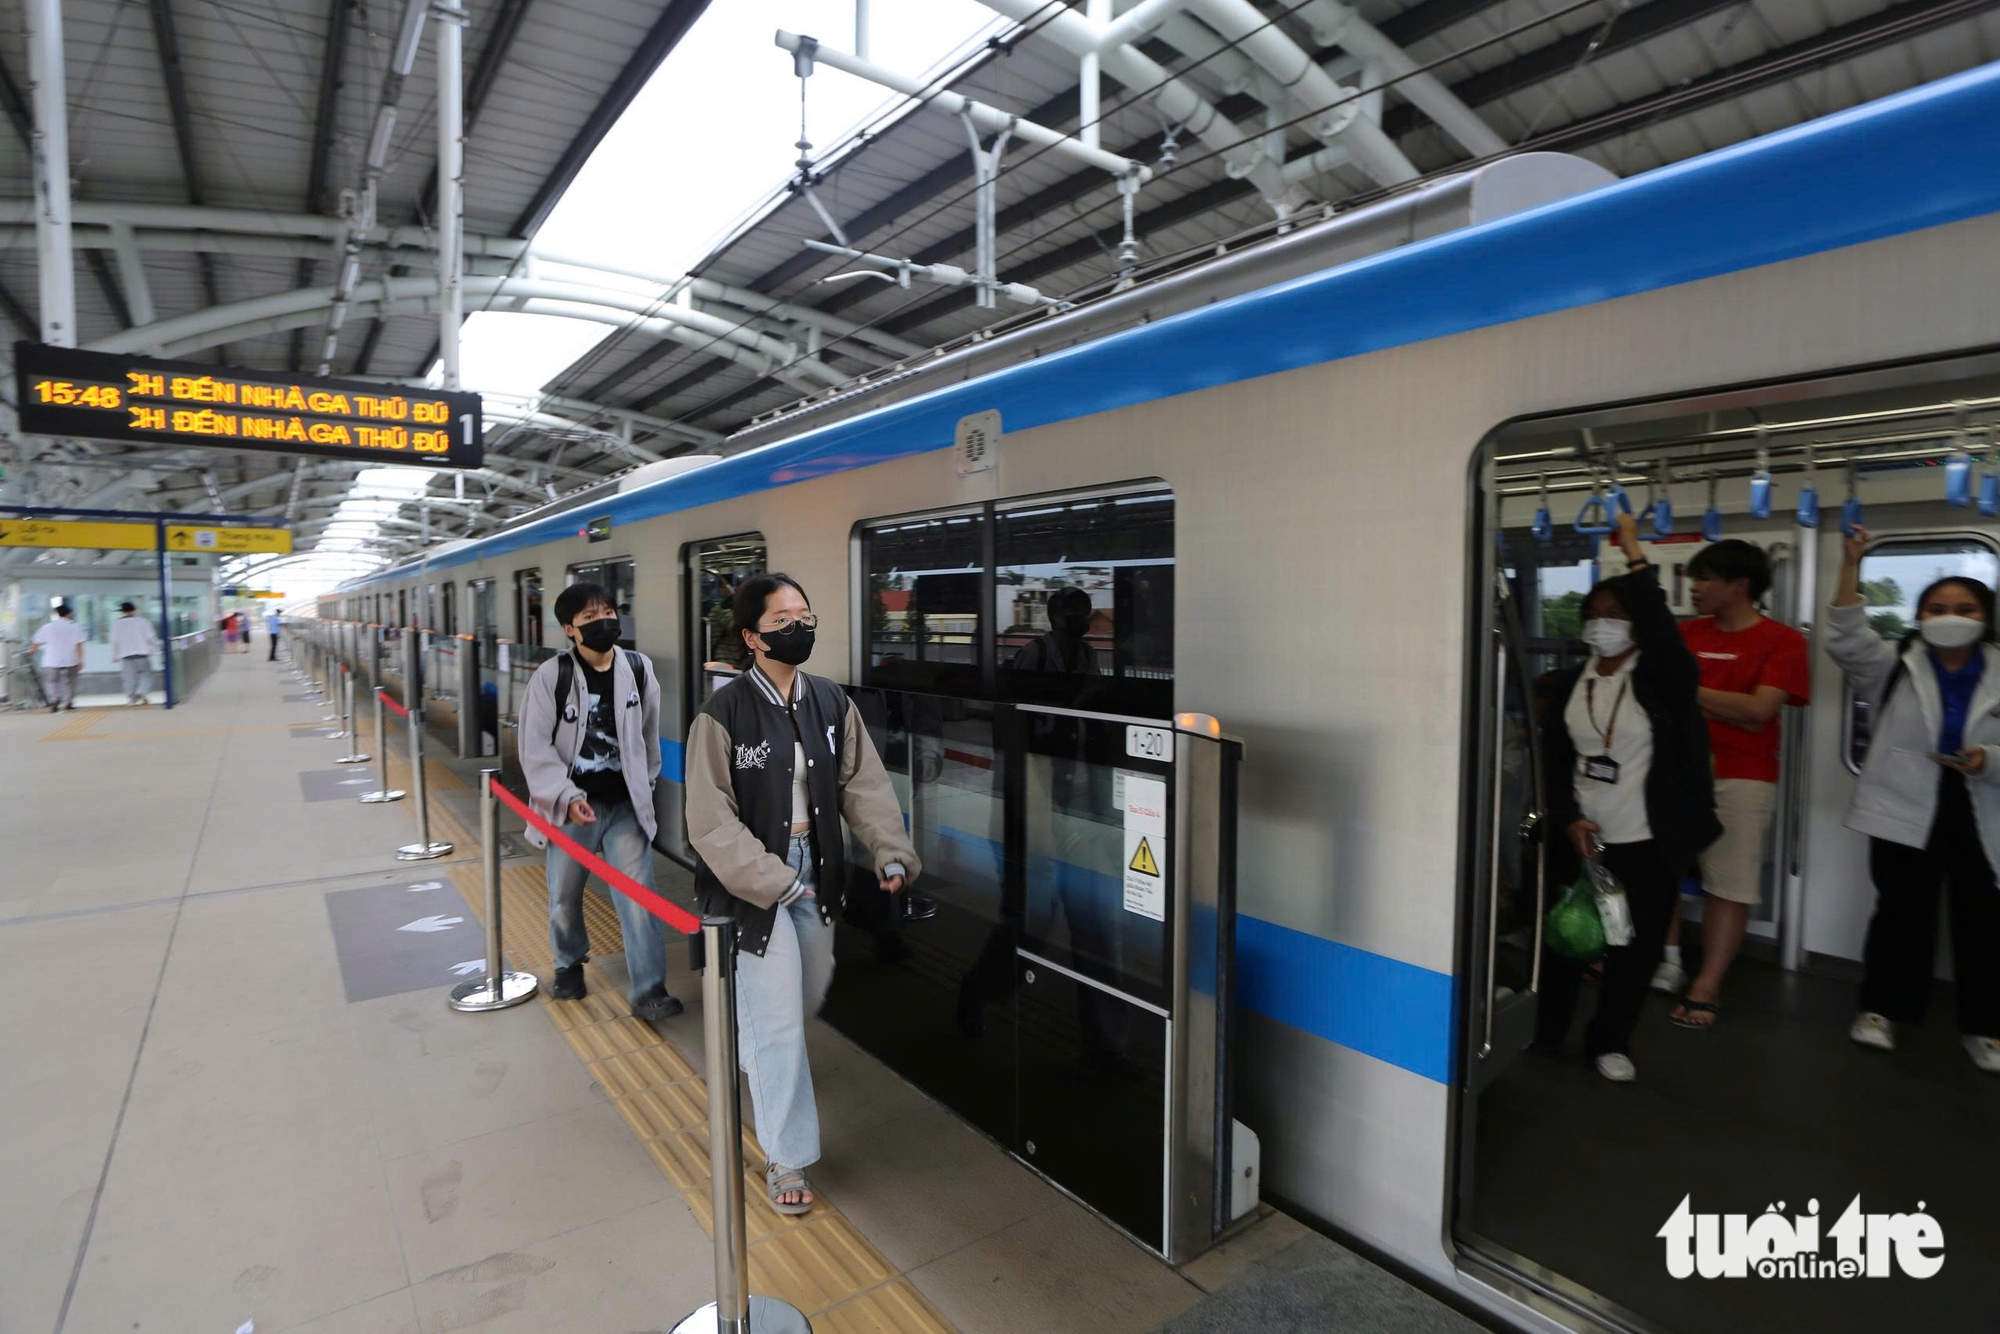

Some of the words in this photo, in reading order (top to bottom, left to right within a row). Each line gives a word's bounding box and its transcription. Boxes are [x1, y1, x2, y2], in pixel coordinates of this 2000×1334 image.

[34, 379, 121, 409] 15:48
[240, 384, 308, 410] NHÀ
[307, 391, 351, 415] GA
[241, 416, 309, 442] NHÀ
[307, 423, 352, 446] GA
[459, 413, 474, 445] 1
[1131, 731, 1163, 757] 1-20
